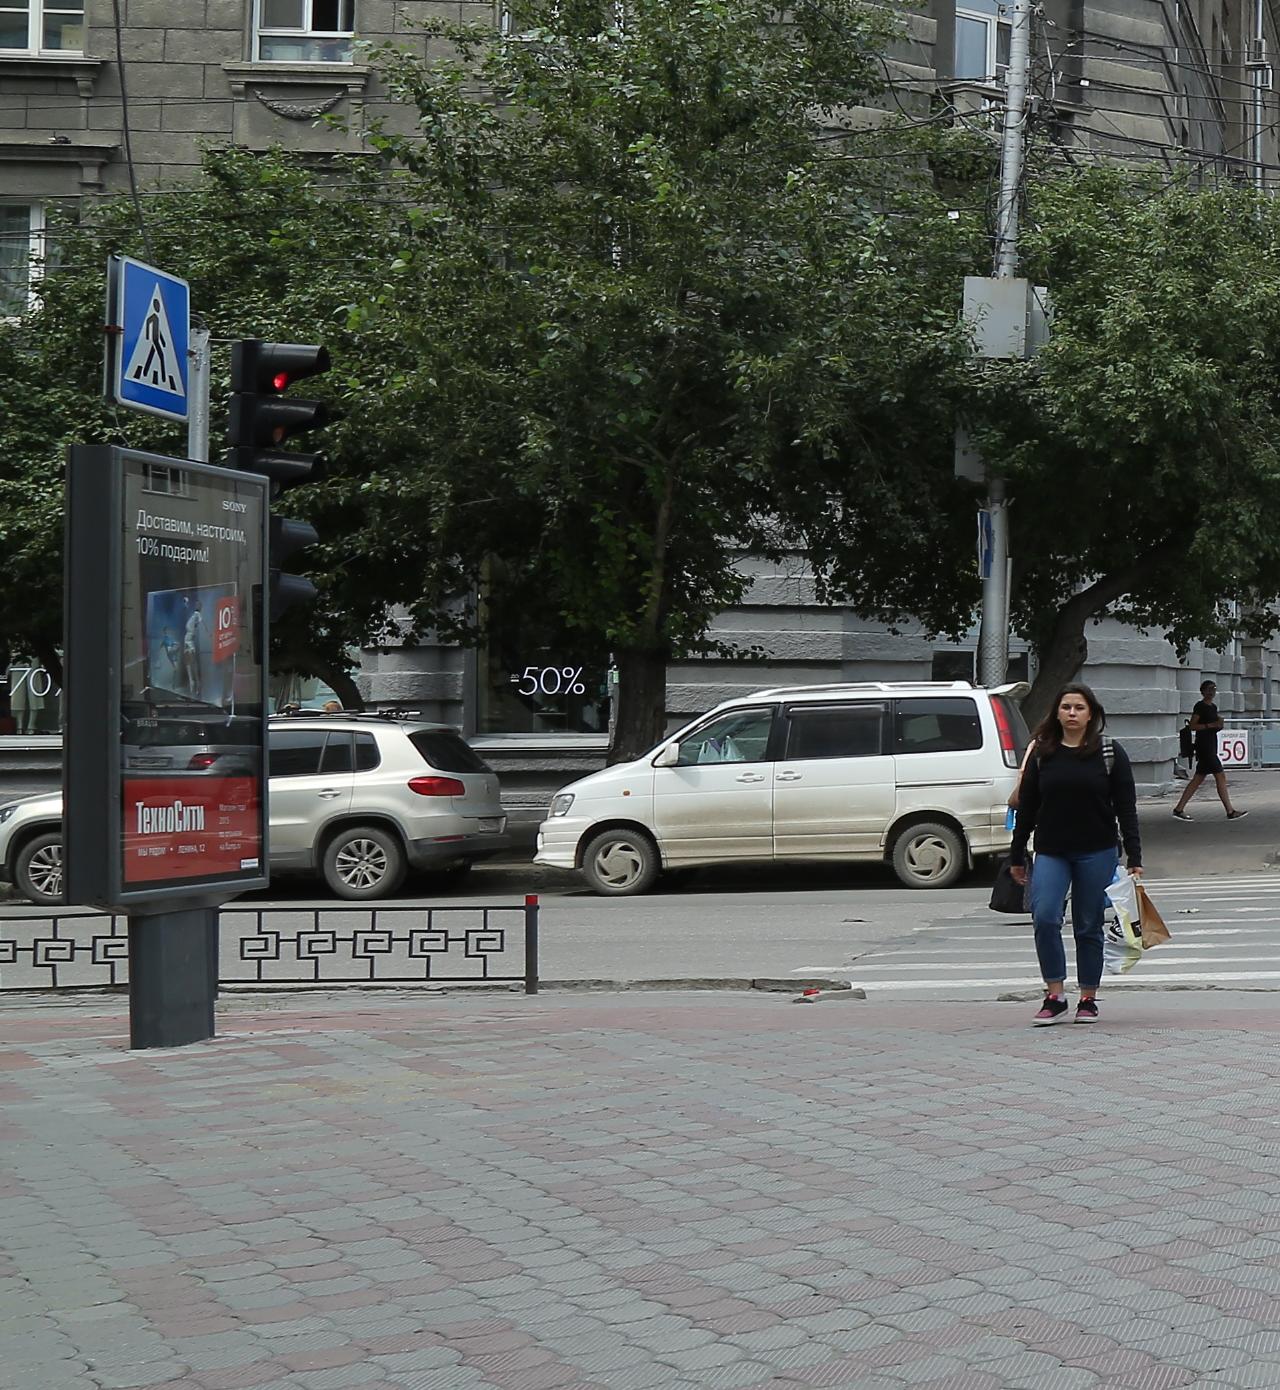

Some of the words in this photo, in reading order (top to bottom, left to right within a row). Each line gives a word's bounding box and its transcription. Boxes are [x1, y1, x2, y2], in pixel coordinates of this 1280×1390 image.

[222, 500, 248, 513] SONY
[136, 509, 195, 537] Доставим,
[196, 523, 247, 546] настроим,
[136, 536, 160, 557] 10%
[160, 544, 210, 564] подарим!
[509, 666, 586, 696] -50%
[1219, 740, 1246, 762] -50
[135, 799, 205, 834] ТехноСити
